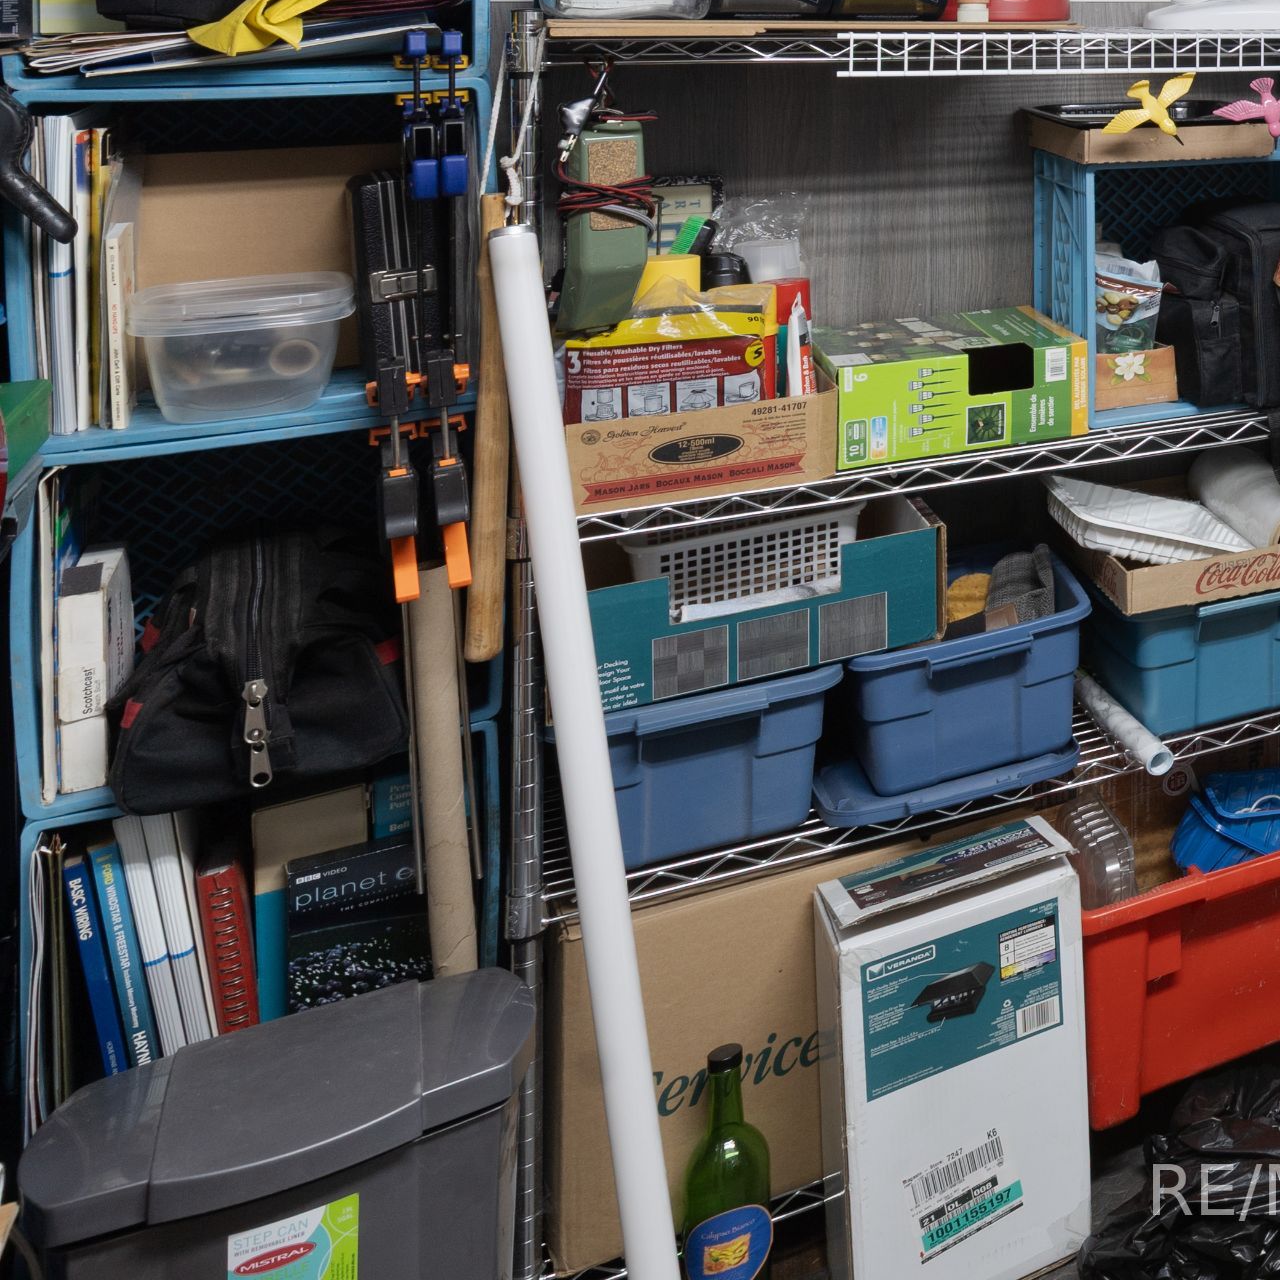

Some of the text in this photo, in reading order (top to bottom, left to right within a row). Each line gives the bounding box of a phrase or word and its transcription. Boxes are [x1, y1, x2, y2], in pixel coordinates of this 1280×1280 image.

[648, 345, 661, 353] Dry
[661, 343, 683, 351] Filters
[567, 351, 581, 374] 3
[602, 367, 619, 375] para
[612, 355, 649, 366] poussières
[751, 401, 807, 416] 49281-41707
[1029, 403, 1037, 433] Ensemble
[602, 428, 639, 443] Golden
[849, 446, 859, 457] 10
[594, 461, 796, 497] MASON JARS BOCAUX MASON BOCCALI MASON
[603, 660, 629, 669] Decking
[612, 675, 632, 684] Space
[82, 668, 93, 715] Scotchcast
[102, 863, 115, 886] FORD
[296, 866, 348, 885] BBC VIDEO
[296, 871, 387, 911] planet
[68, 877, 93, 941] BASIC WIRING
[105, 885, 122, 924] WINDSTAR
[114, 931, 132, 971] FREESTAR
[886, 949, 932, 971] VERANDA
[986, 1128, 998, 1140] K6
[946, 1147, 964, 1161] 7247
[973, 1182, 993, 1197] 008
[927, 1188, 1012, 1243] 1001155197
[233, 1218, 309, 1251] STEP CAN
[240, 1247, 310, 1273] MISTRAL
